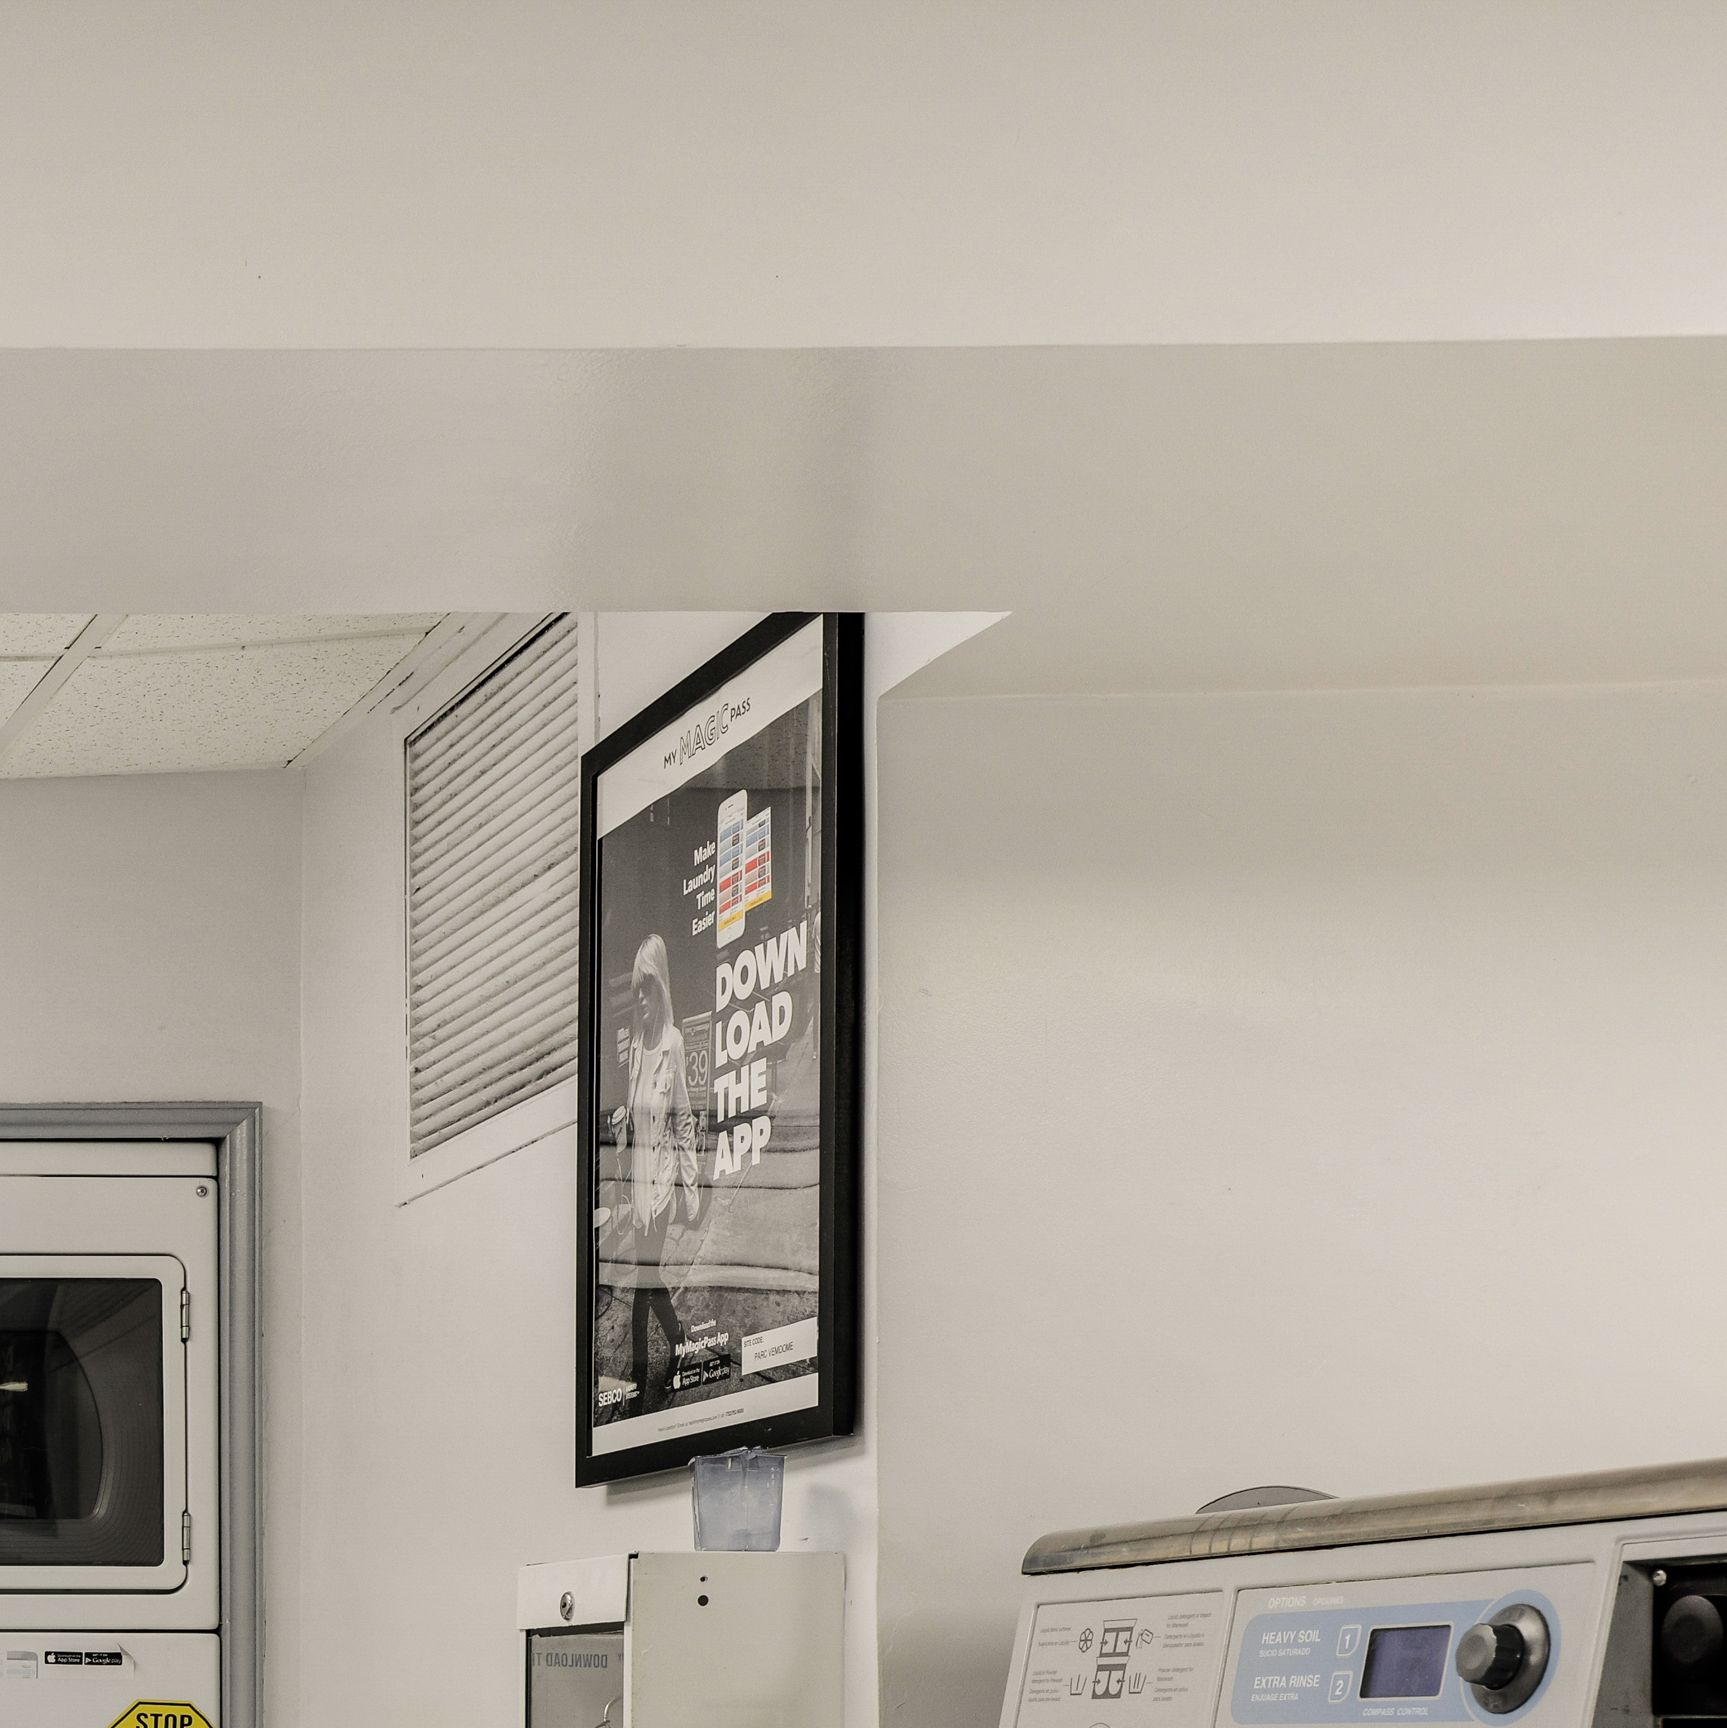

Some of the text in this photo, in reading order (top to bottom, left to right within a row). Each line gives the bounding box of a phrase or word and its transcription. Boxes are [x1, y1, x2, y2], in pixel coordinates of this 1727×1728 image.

[663, 697, 751, 769] MY MAGIC PASS
[693, 840, 716, 866] Make
[683, 864, 716, 896] Laundry
[696, 888, 715, 910] Time
[692, 910, 715, 936] Easier
[716, 920, 807, 1013] DOWN
[715, 991, 793, 1069] LOAD
[714, 1057, 767, 1123] THE
[713, 1115, 771, 1181] APP
[675, 1331, 730, 1357] MyMagicPass App
[598, 1387, 622, 1407] SEBCO
[1261, 1629, 1322, 1645] HEAVY SOIL
[1344, 1633, 1352, 1649] 1
[1253, 1674, 1321, 1690] EXTRA RINSE
[1334, 1679, 1345, 1696] 2
